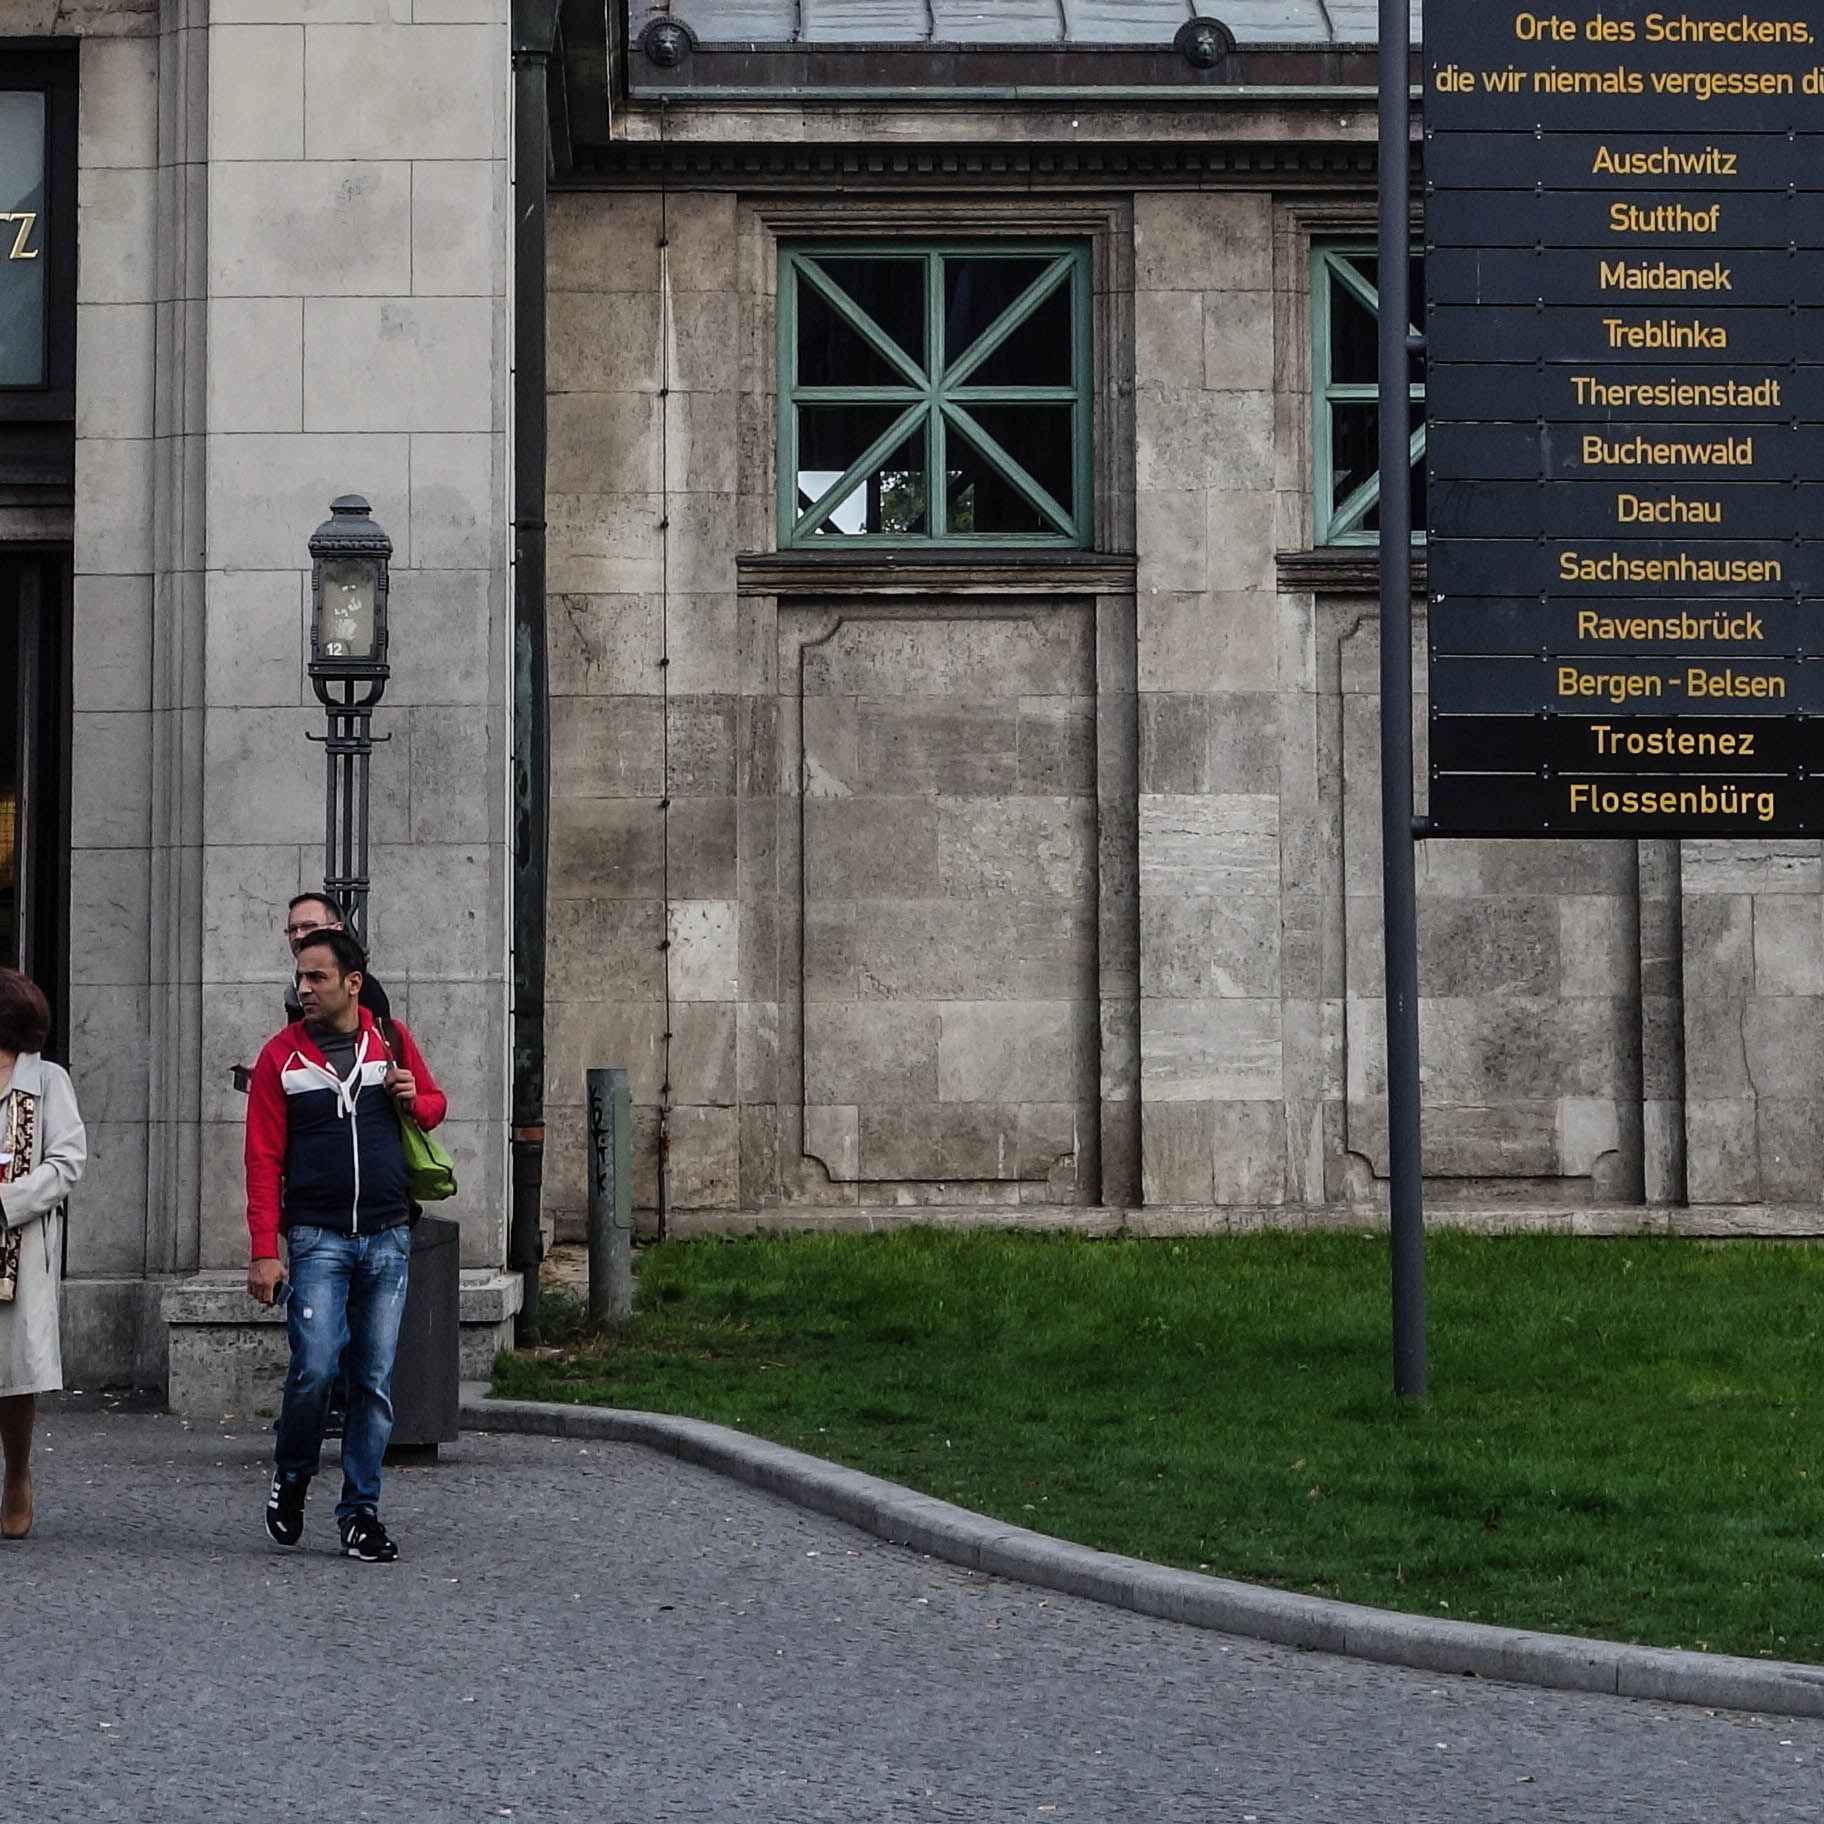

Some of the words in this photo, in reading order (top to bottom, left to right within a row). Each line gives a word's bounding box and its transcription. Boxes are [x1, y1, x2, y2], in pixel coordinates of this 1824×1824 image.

[1515, 12, 1577, 41] Orte
[1585, 15, 1636, 41] des
[1437, 65, 1474, 92] die
[1484, 65, 1524, 91] wir
[1533, 66, 1644, 93] niemals
[1651, 73, 1793, 101] vergessen
[1593, 147, 1737, 174] Auschwitz
[1610, 203, 1719, 233] Stutthof
[1600, 263, 1729, 289] Maidanek
[1603, 319, 1727, 348] Treblinka
[1570, 377, 1779, 405] Theresienstadt
[1583, 436, 1753, 465] Buchenwald
[1618, 493, 1721, 522] Dachau
[1559, 551, 1780, 581] Sachsenhausen
[1579, 611, 1761, 640] Ravensbrück
[1591, 724, 1753, 756] Trostenez
[1569, 783, 1774, 822] Flossenbürg
